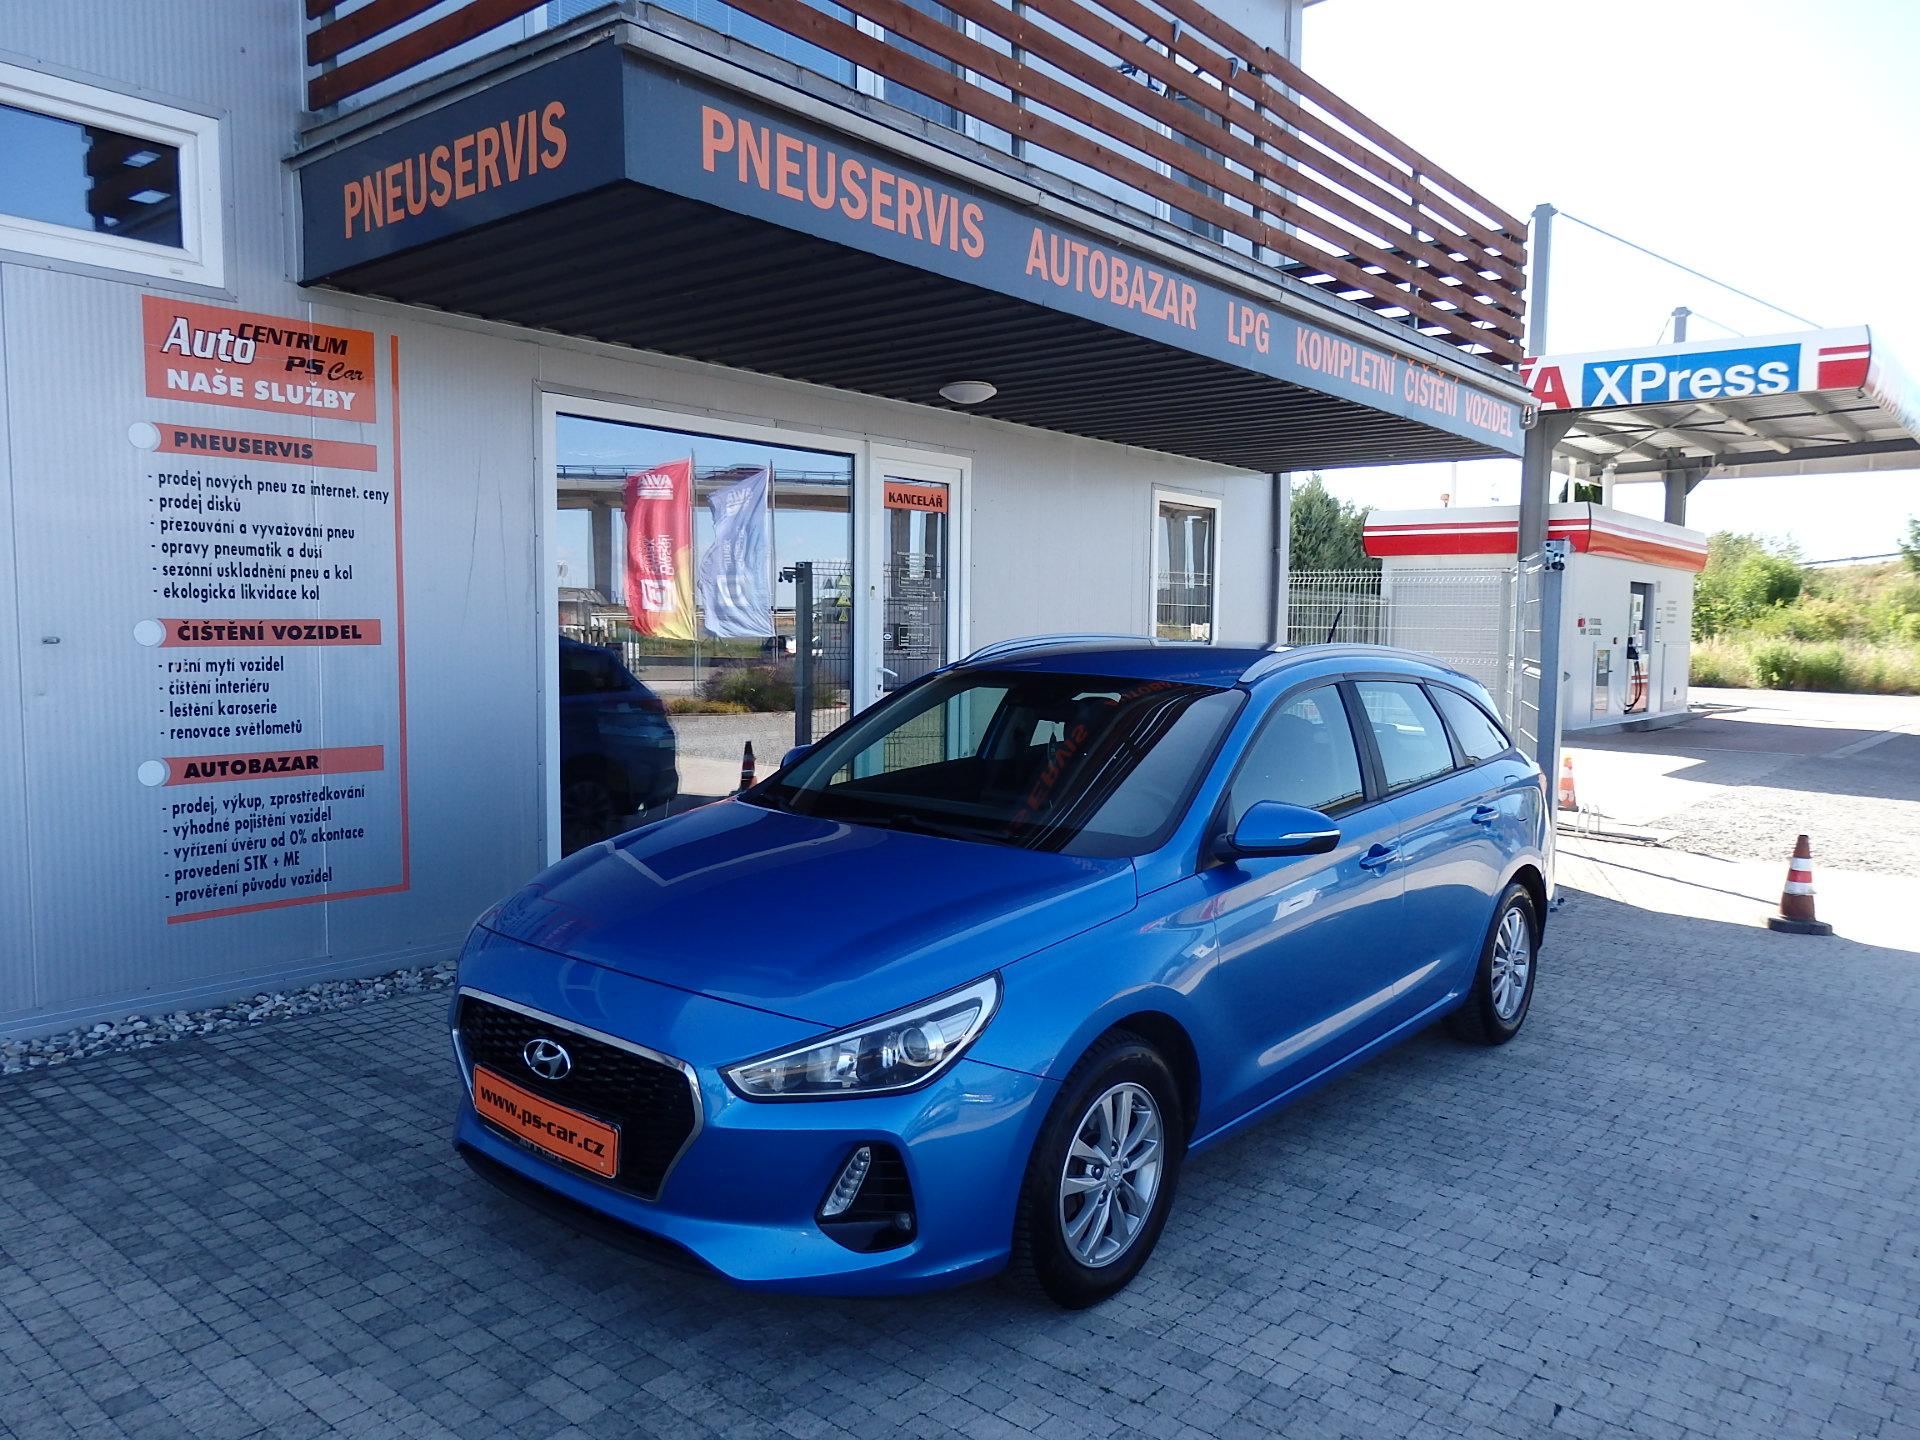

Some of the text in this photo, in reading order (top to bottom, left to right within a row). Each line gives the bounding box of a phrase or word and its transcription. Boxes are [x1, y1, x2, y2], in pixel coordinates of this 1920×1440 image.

[343, 100, 568, 240] PNEUSERVIS
[700, 105, 1513, 438] PNEUSERVIS AUTOBAZAR LPG KOMPLETNÍ ČIŠTĚNÍ VOZIDEL
[161, 316, 348, 364] Auto CENTRUM
[285, 355, 364, 381] PS Car
[167, 368, 355, 411] NAŠE SLUŽBY
[1592, 360, 1790, 407] XPress
[174, 431, 313, 458] PNEUSERVIS
[158, 470, 201, 490] prodej
[206, 474, 252, 493] nových
[257, 481, 287, 495] pneu
[292, 483, 305, 494] za
[363, 489, 389, 504] ceny
[888, 492, 943, 508] KANCELÁŘ
[159, 493, 202, 514] prodej
[161, 516, 355, 541] přezouvání a vyvažování pneu
[161, 541, 209, 557] opravy
[214, 541, 282, 558] pneumatik
[287, 546, 294, 557] a
[162, 561, 353, 580] sezónní uskladnění pneu a kol
[163, 582, 320, 603] ekologická likvidace kol
[177, 620, 362, 641] ČIŠTĚNÍ VOZIDEL
[205, 658, 236, 676] mytí
[240, 655, 284, 672] vozidel
[169, 678, 270, 695] čištění interiéru
[170, 699, 277, 717] leštění karoserie
[170, 719, 303, 739] renovace světlometů
[183, 755, 319, 779] AUTOBAZAR
[172, 785, 365, 819] prodej, výkup, zprostředkování
[173, 806, 332, 840] výhodné pojištění vozidel
[174, 826, 364, 862] vyřízení úvěru od 0% akontace
[174, 859, 240, 885] provedení
[244, 854, 268, 872] STK
[283, 850, 300, 867] ME
[175, 867, 333, 906] prověření původu vozidel
[480, 1085, 605, 1158] www.ps-car.cz
